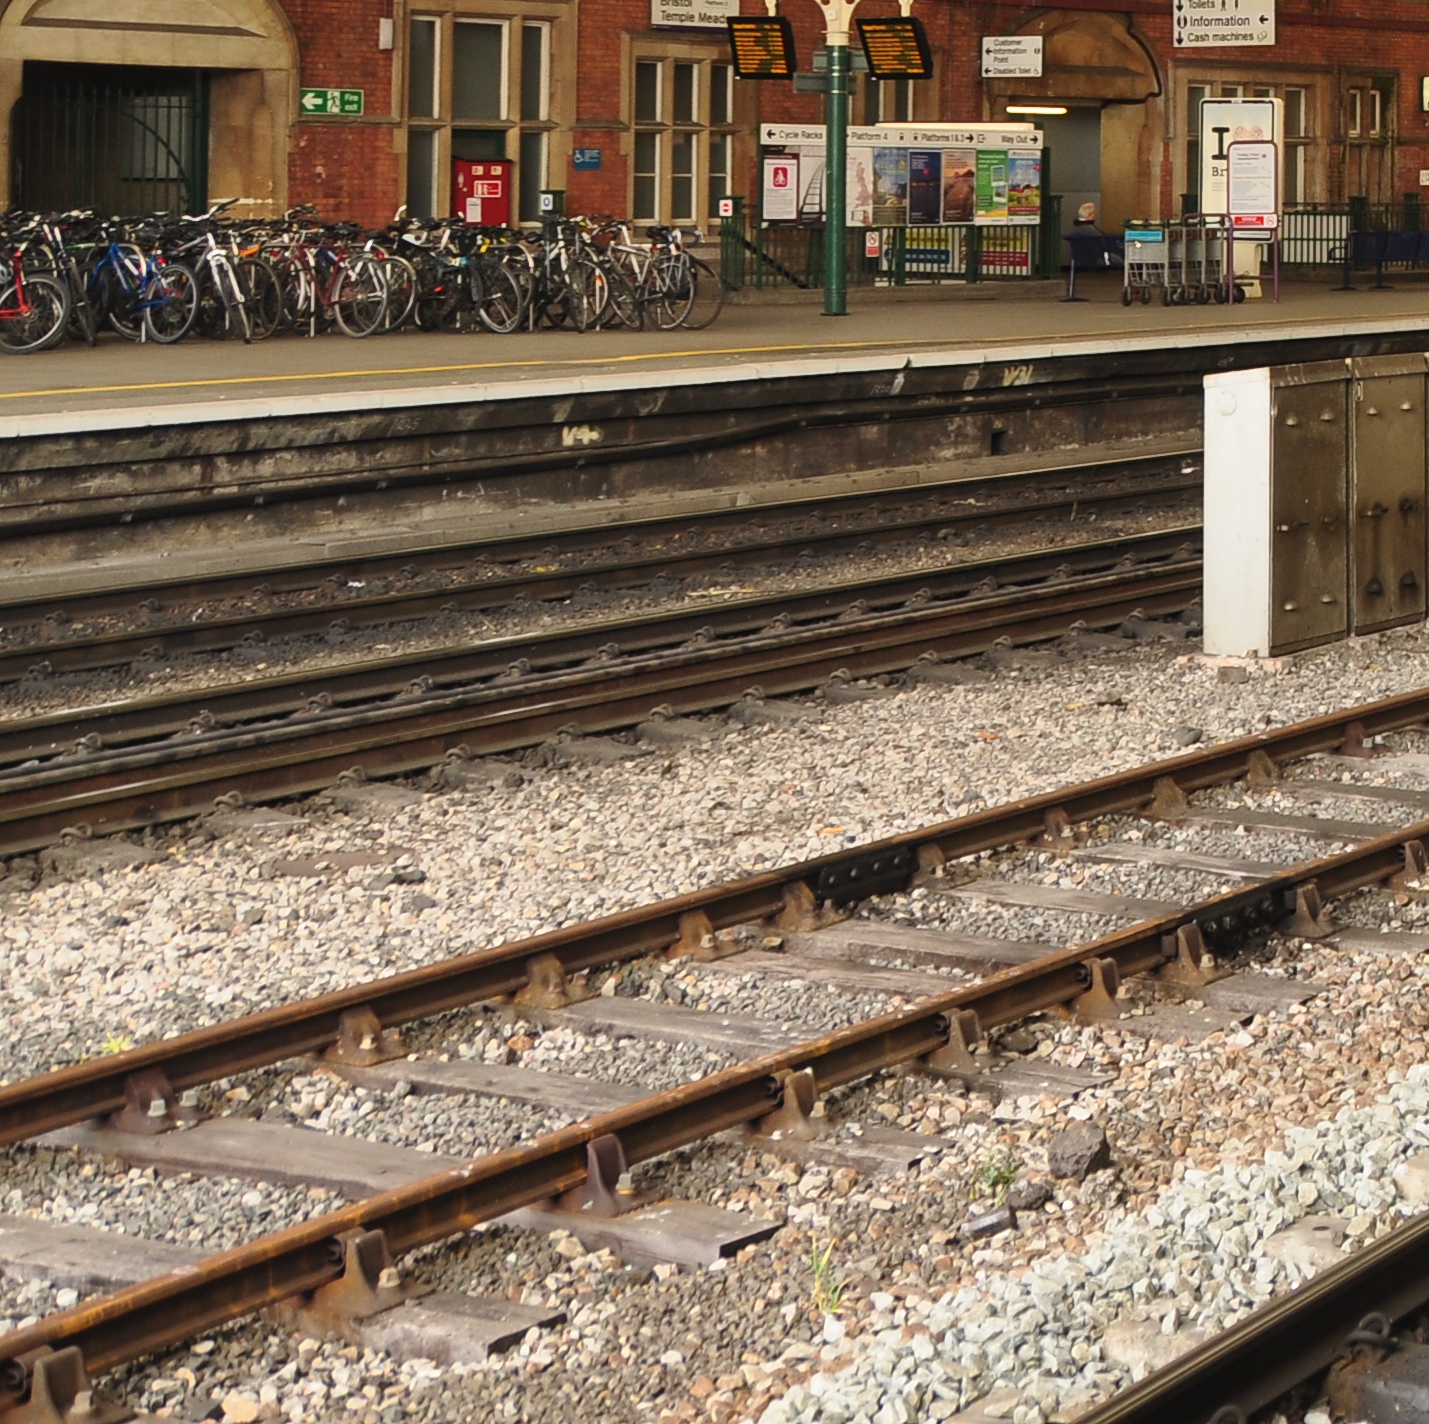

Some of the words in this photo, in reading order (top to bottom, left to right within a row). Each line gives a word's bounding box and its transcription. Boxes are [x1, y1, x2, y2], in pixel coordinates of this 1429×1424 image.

[1188, 0, 1216, 9] Toilets
[660, 10, 695, 23] Temple
[1190, 15, 1250, 27] Information
[1187, 32, 1210, 42] Cash
[1212, 30, 1254, 41] machines
[779, 130, 799, 139] Cycle
[802, 131, 823, 139] Racks
[851, 132, 880, 140] Platform
[1001, 136, 1014, 144] Way
